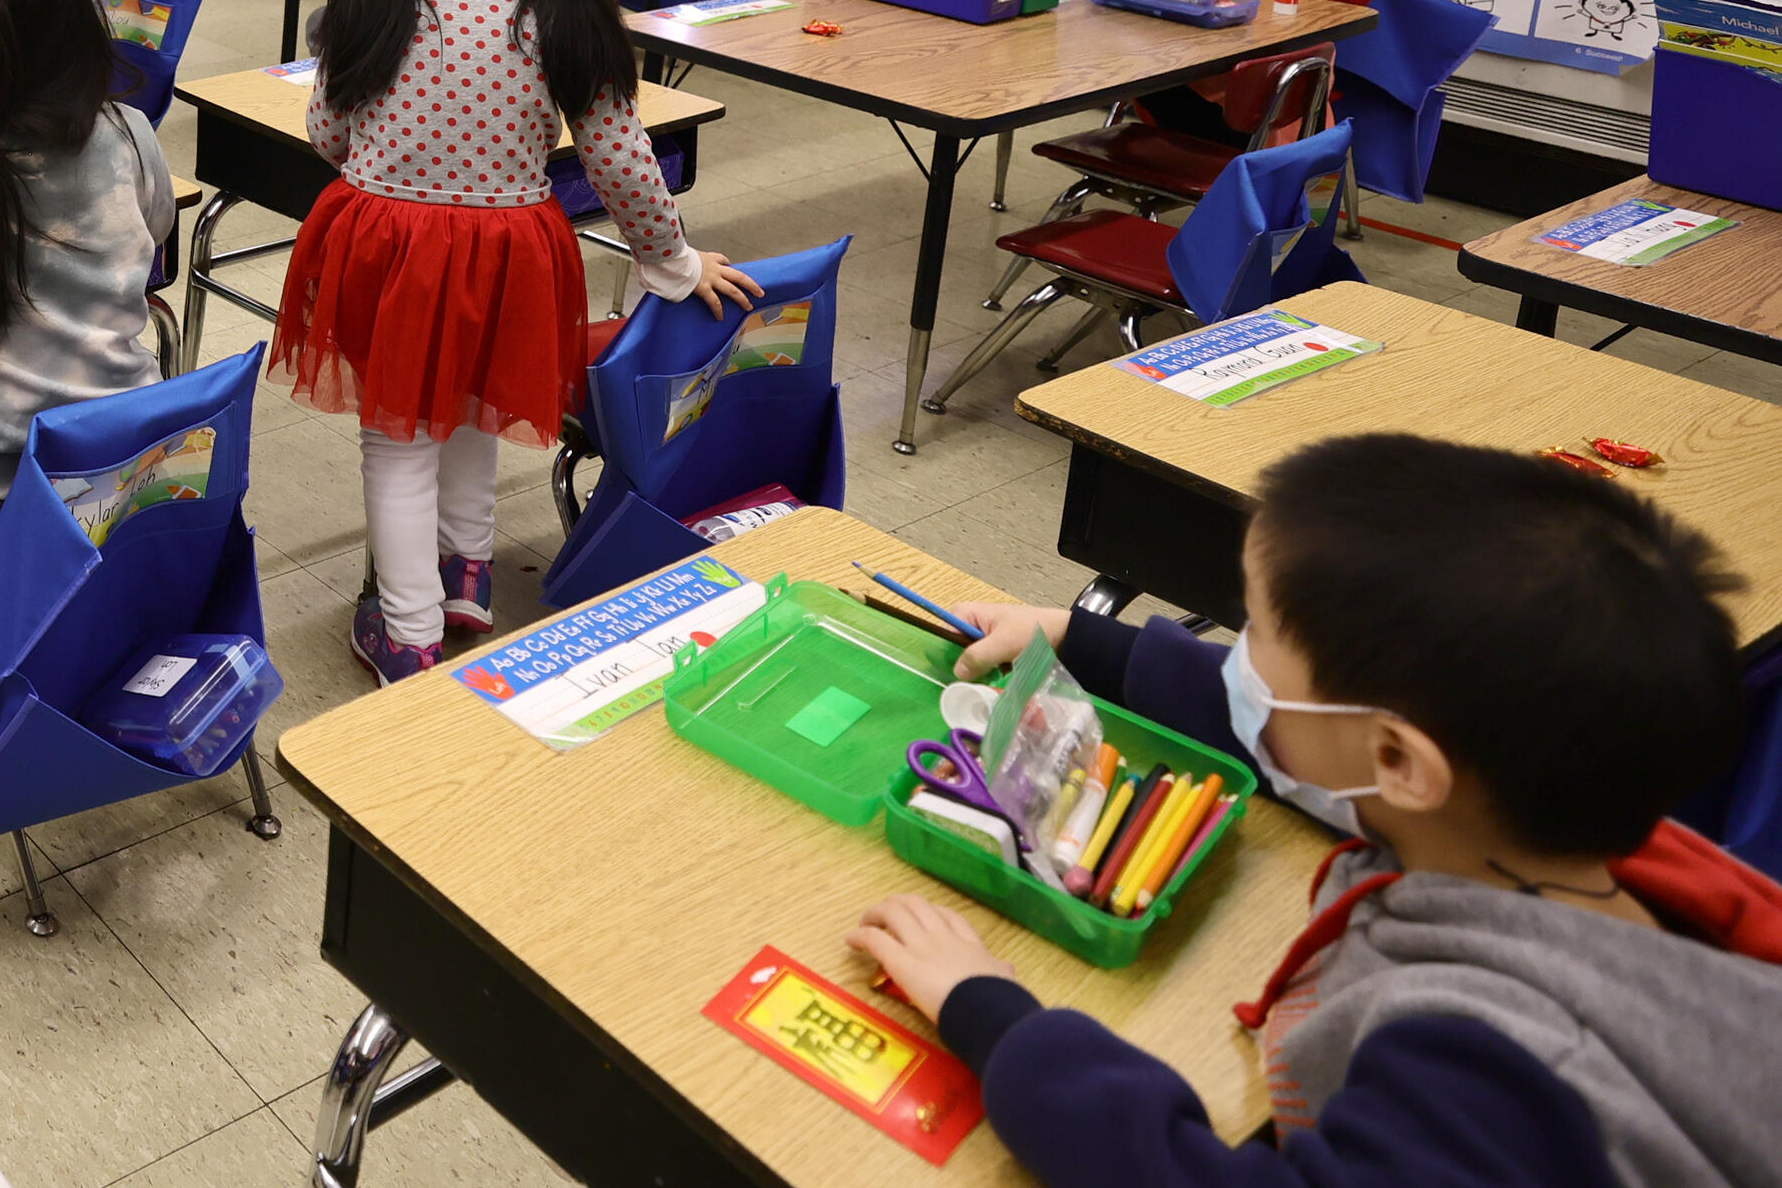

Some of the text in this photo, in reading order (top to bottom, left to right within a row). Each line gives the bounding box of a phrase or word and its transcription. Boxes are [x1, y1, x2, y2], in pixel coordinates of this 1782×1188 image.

[1722, 15, 1779, 35] Michael
[71, 499, 119, 538] ylar
[555, 662, 635, 699] Ivan
